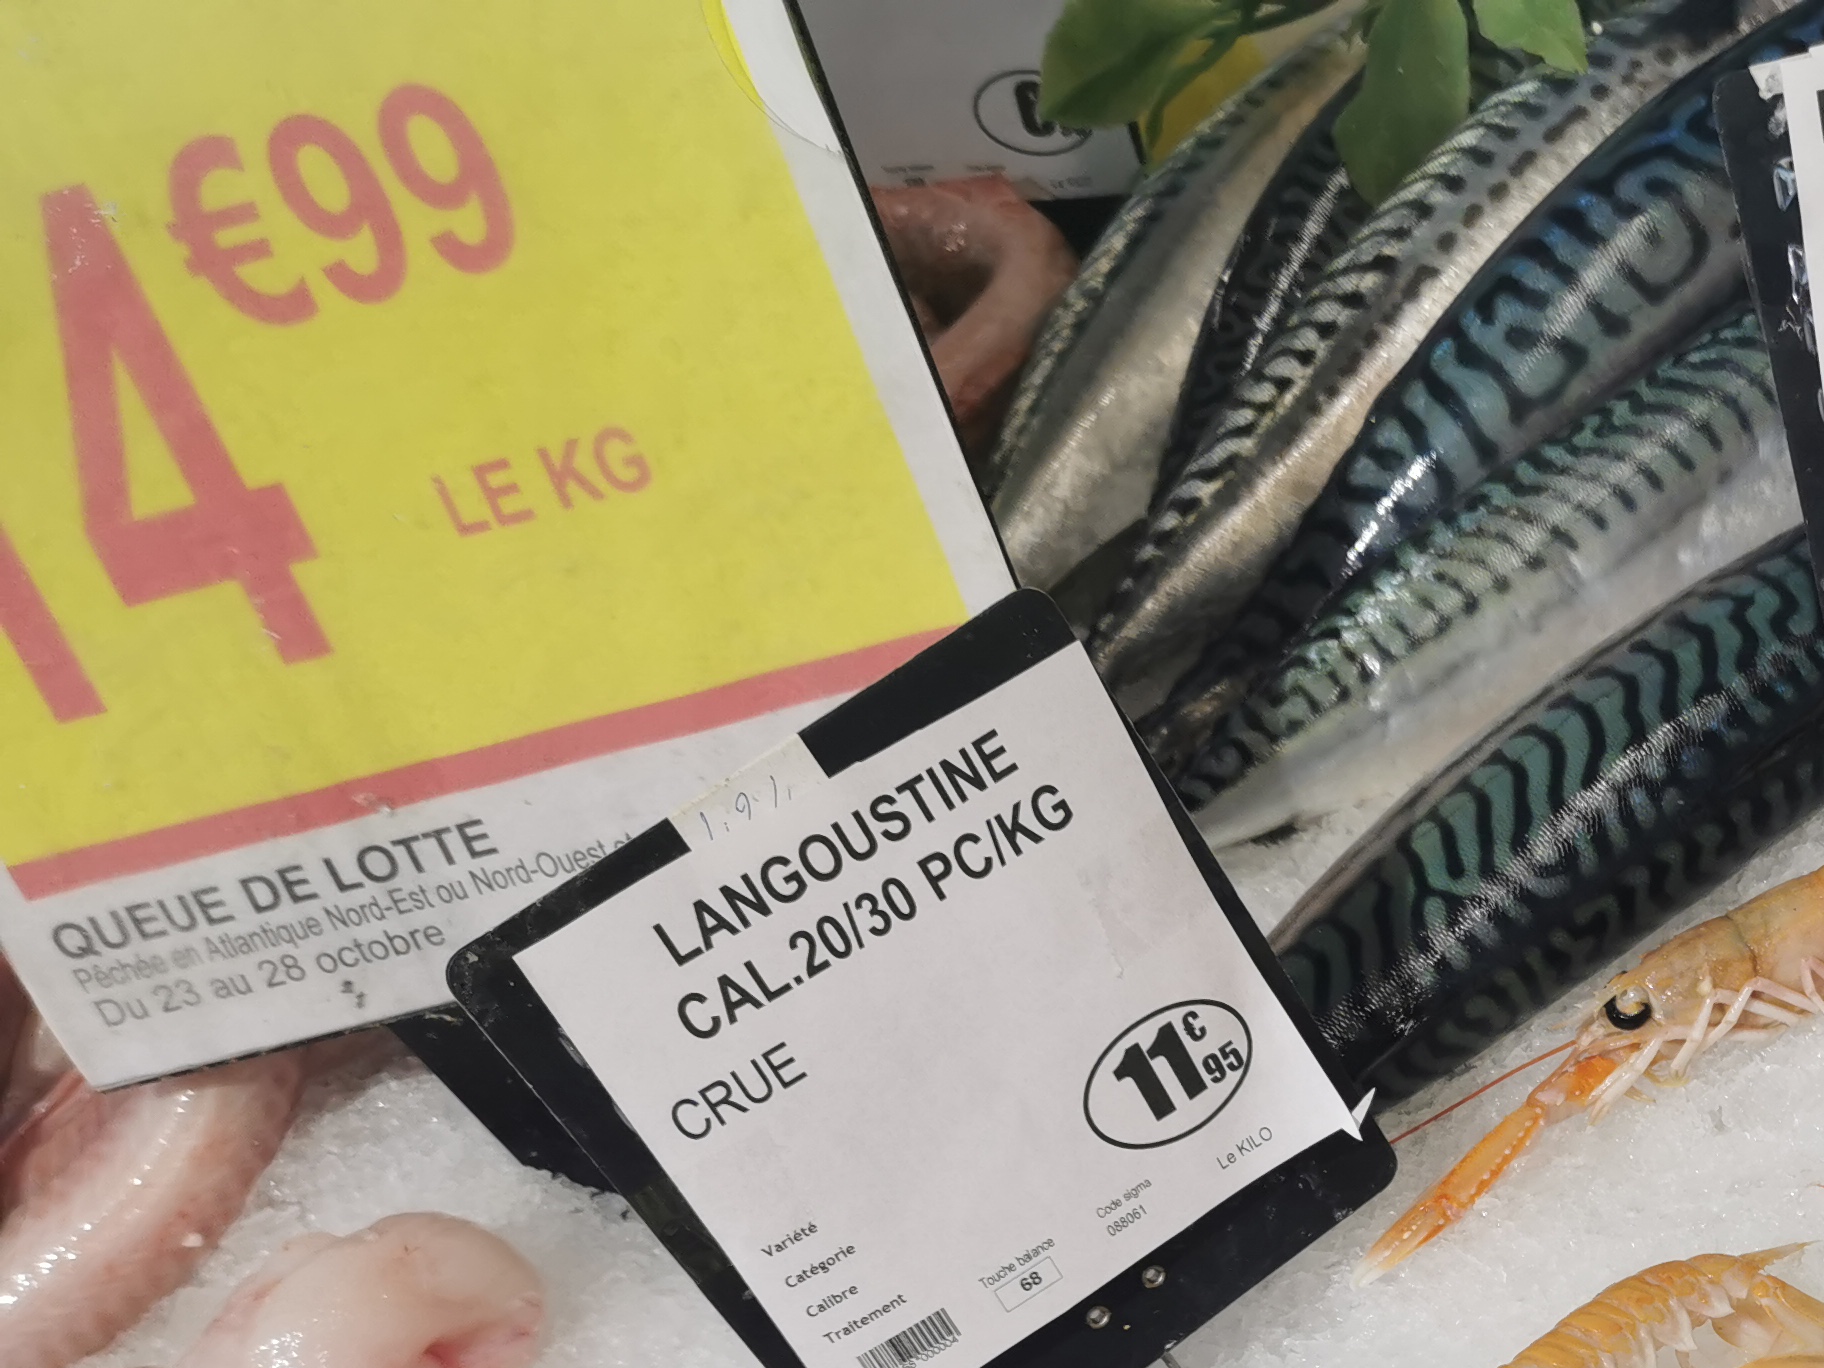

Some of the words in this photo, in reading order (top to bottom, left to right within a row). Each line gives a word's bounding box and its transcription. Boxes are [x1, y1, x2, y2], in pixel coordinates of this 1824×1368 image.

[431, 459, 535, 538] LE
[537, 427, 652, 510] KG
[652, 729, 1019, 966] LANGOUSTINE
[52, 886, 236, 959] QUEUE
[238, 865, 320, 914] DE
[322, 819, 499, 893] LOTTE
[170, 947, 204, 970] en
[204, 914, 324, 961] Atlantique
[324, 883, 435, 931] Nord-Est
[437, 877, 469, 905] ou
[469, 840, 608, 895] Nord-Ouest
[676, 878, 917, 1039] CAL.20/30
[917, 784, 1074, 901] PC/KG
[94, 997, 150, 1028] Du
[153, 979, 201, 1013] 23
[211, 973, 254, 999] au
[257, 953, 305, 988] 28
[316, 924, 445, 974] octobre
[671, 1042, 807, 1141] CRUE
[1113, 1021, 1208, 1121] 11
[1202, 1040, 1244, 1083] 95
[1216, 1151, 1237, 1170] Le
[1236, 1127, 1273, 1156] KILO
[1096, 1195, 1122, 1219] Code
[1123, 1178, 1152, 1202] sigma
[1107, 1205, 1148, 1236] 088061
[761, 1221, 818, 1257] Variété
[978, 1262, 1017, 1289] Touche
[1017, 1237, 1055, 1267] balance
[785, 1243, 856, 1288] Catégorie
[1020, 1271, 1042, 1292] 68
[806, 1284, 858, 1317] Calibre
[823, 1293, 907, 1343] Traitement
